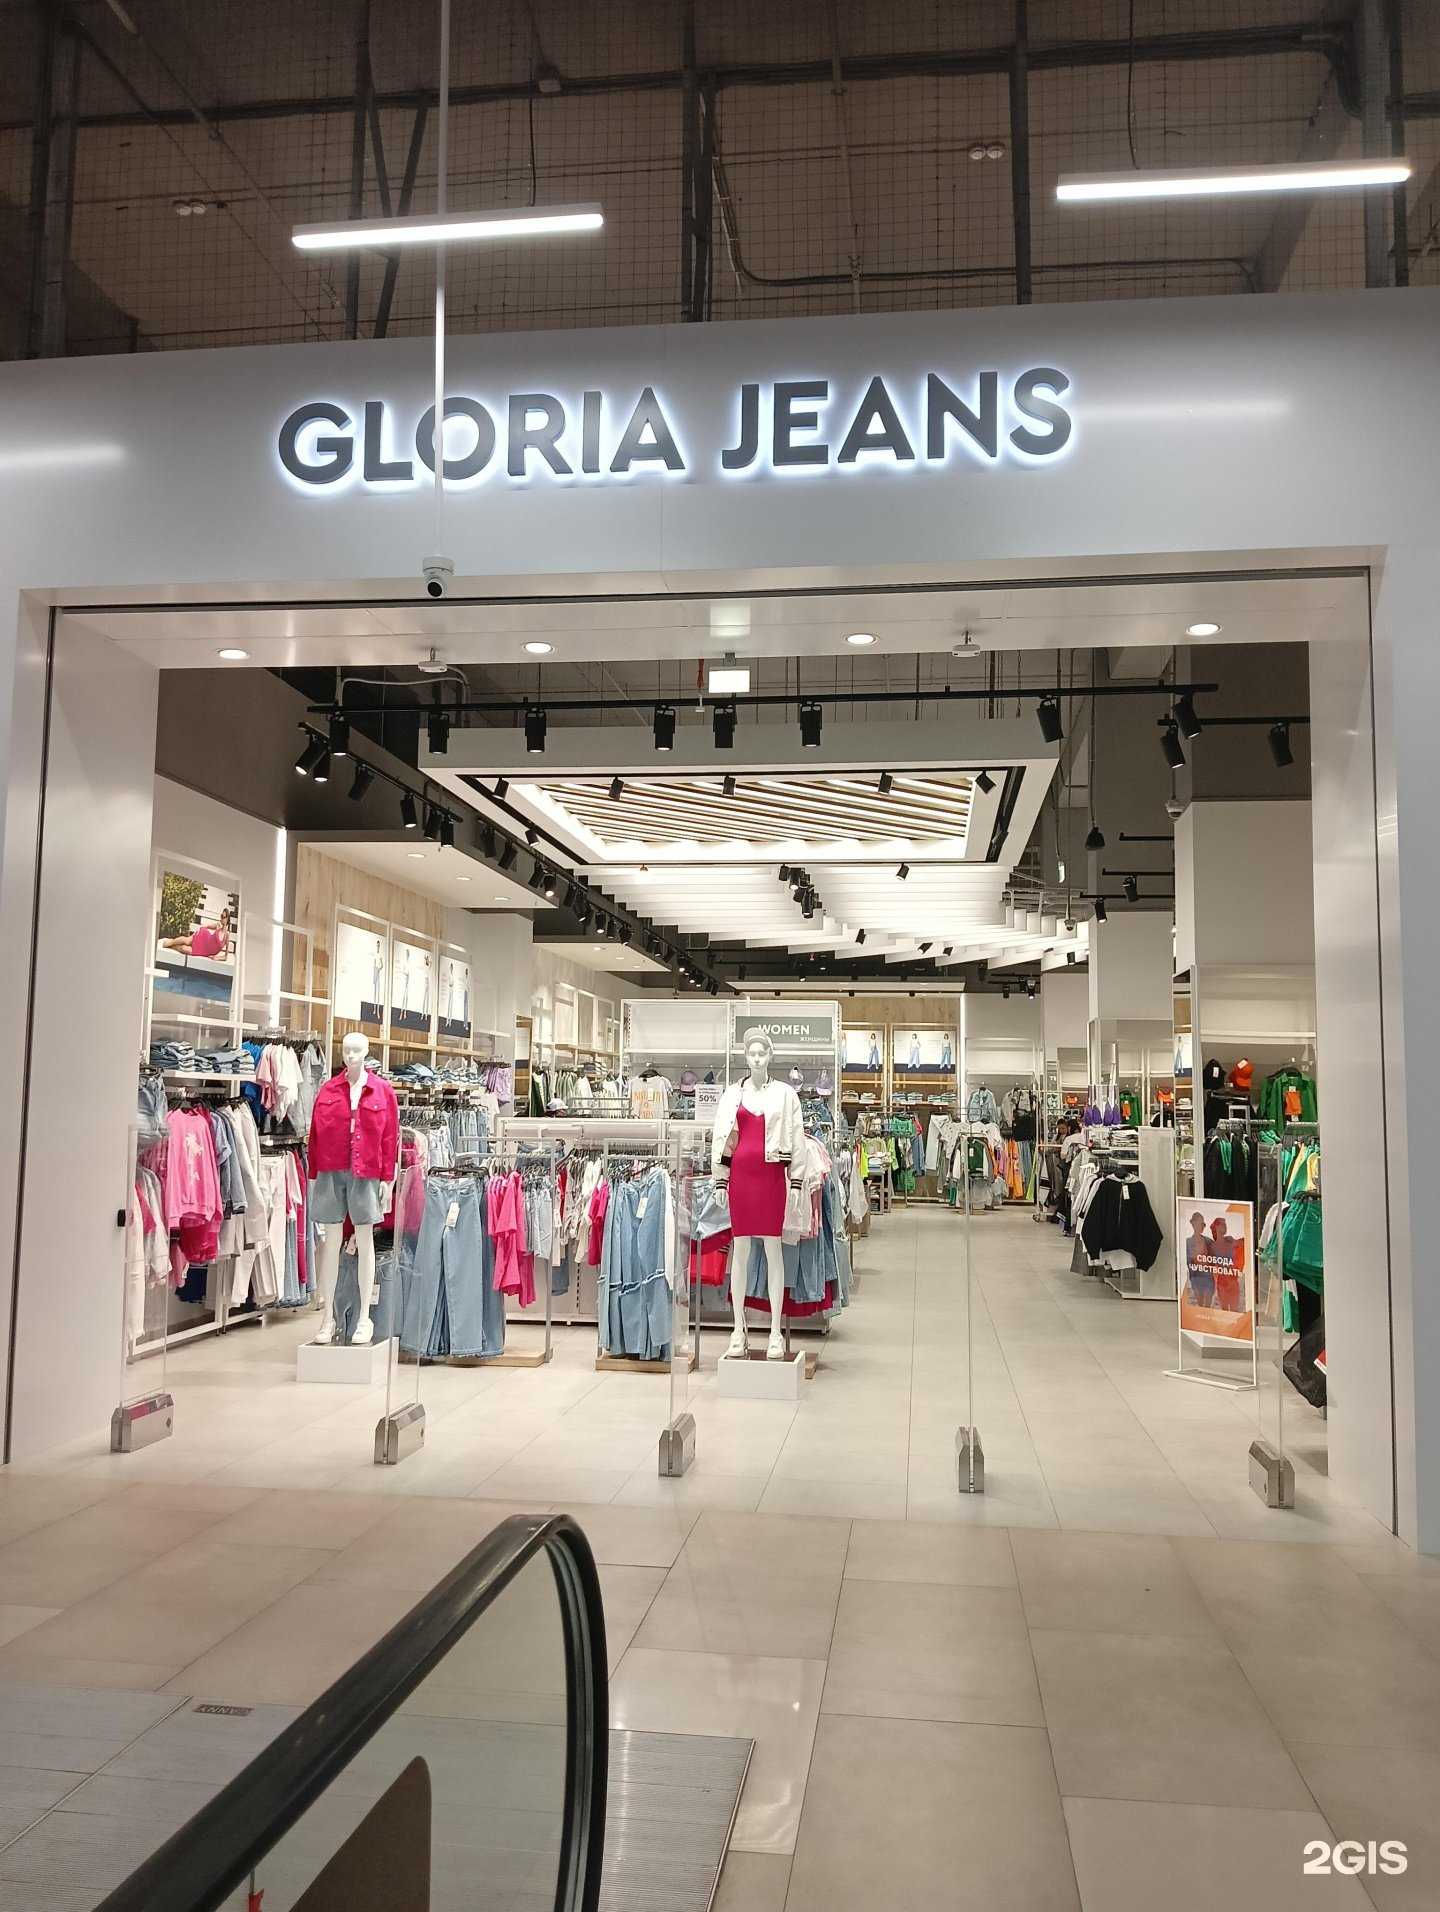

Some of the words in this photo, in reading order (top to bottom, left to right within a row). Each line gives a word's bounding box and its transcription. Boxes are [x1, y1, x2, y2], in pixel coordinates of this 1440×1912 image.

[278, 387, 686, 485] GLORIA
[722, 367, 1072, 470] JEANS
[758, 1024, 811, 1035] WOMEN
[698, 1094, 717, 1102] 50%
[1196, 1254, 1234, 1266] СВОБОДА
[1189, 1263, 1243, 1277] ЧУВСТВОВАТЬ
